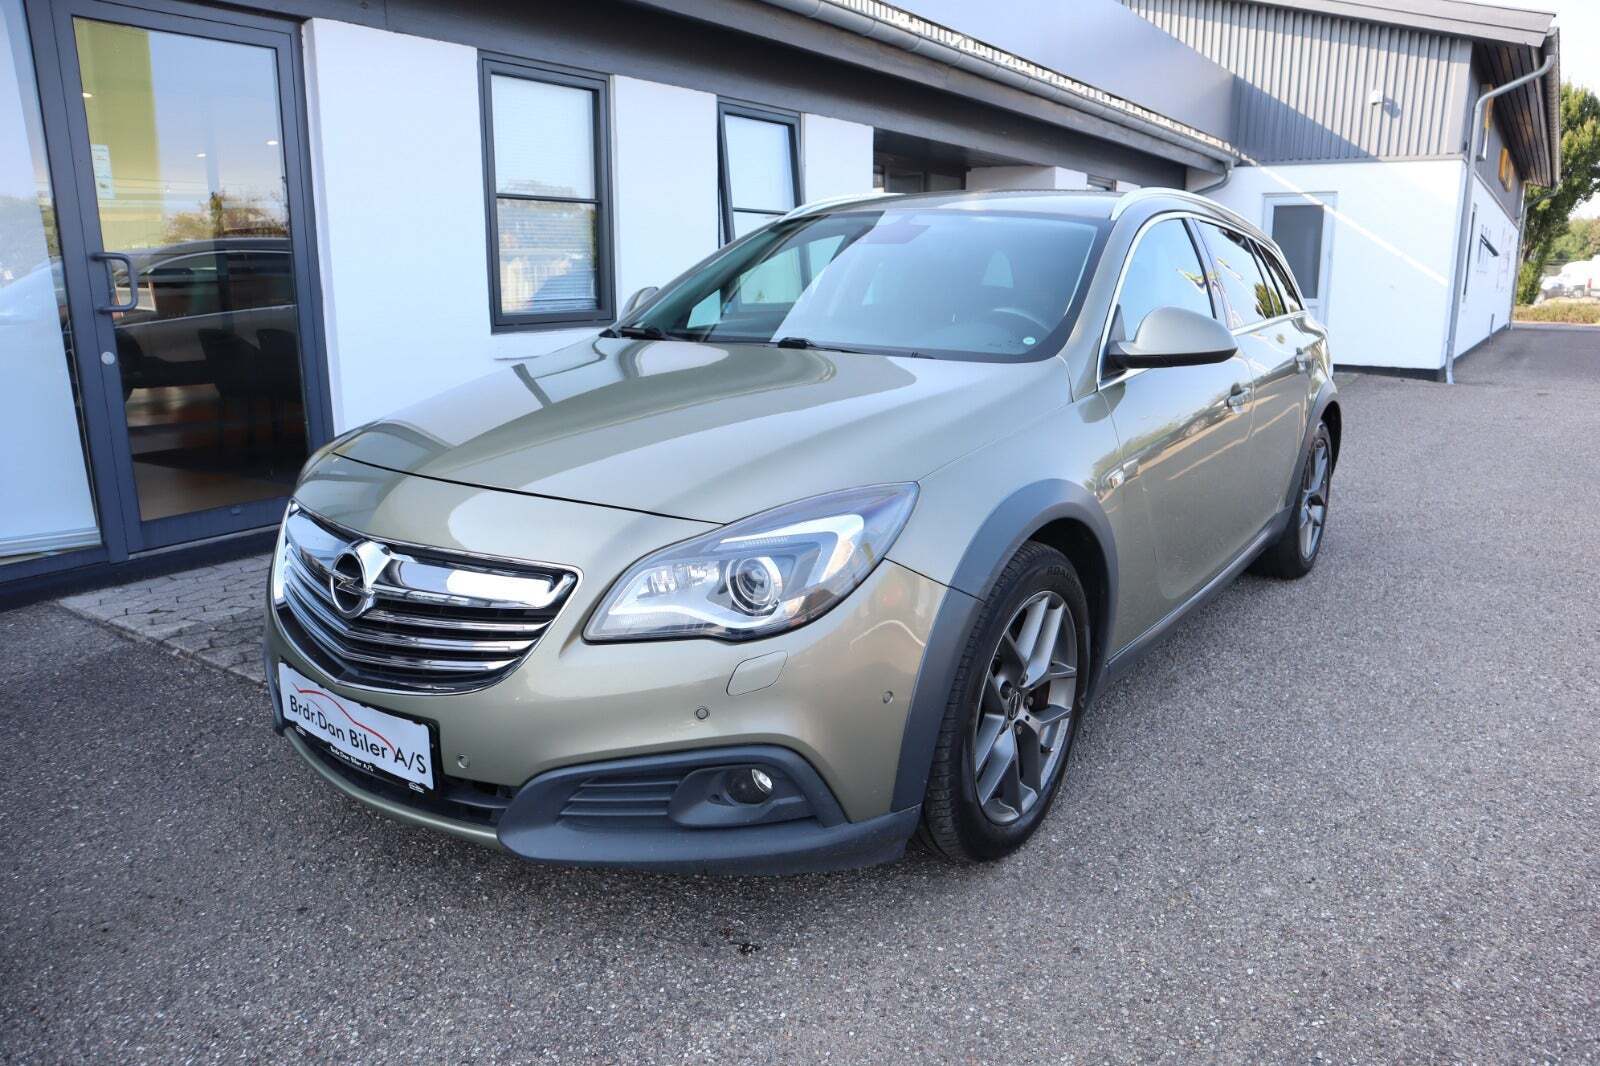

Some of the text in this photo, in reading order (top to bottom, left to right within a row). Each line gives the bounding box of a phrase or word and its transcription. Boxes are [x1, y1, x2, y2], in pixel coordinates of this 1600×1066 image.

[290, 695, 345, 742] Brdr.Dan
[350, 729, 388, 759] Biler
[394, 747, 426, 775] A/S
